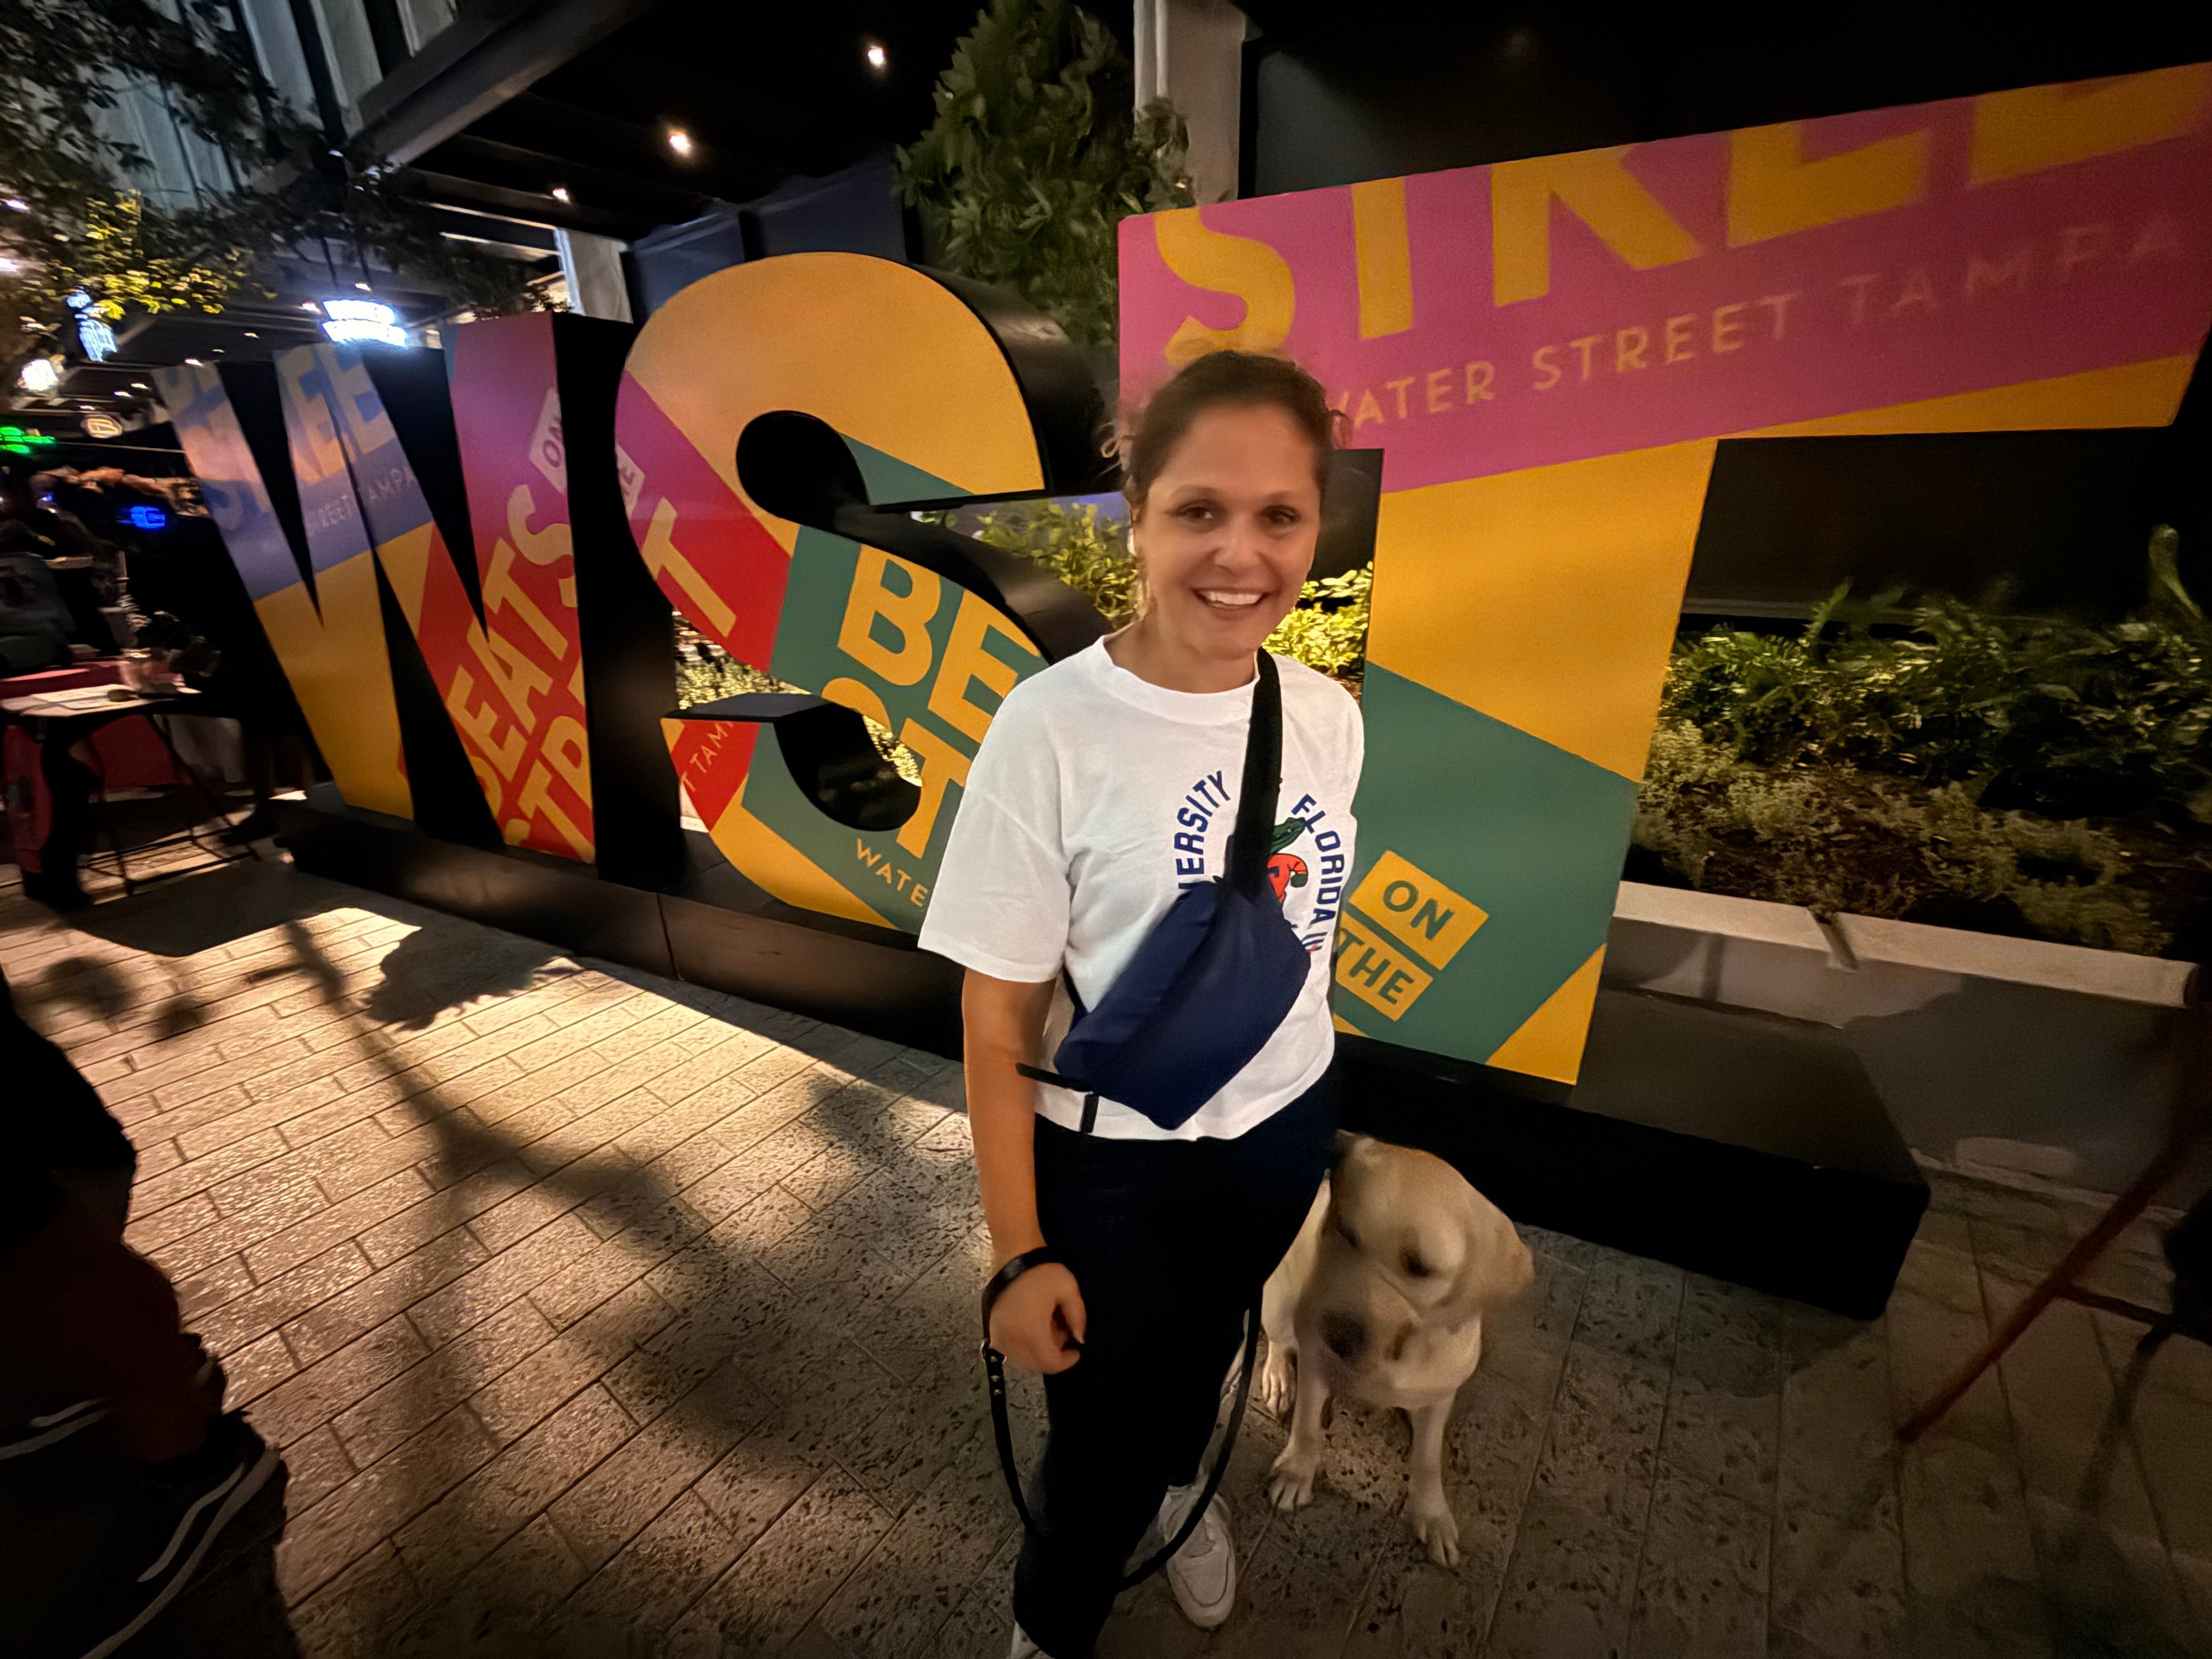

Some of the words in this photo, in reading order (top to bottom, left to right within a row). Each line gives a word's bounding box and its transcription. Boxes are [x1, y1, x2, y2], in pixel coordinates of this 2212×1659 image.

[1532, 290, 1803, 391] STREET
[1837, 213, 2186, 328] TAMPA
[837, 544, 1041, 744] BE
[689, 721, 734, 774] TAM
[1173, 770, 1231, 889] ERSITY
[1291, 793, 1345, 930] FLORIDA
[1338, 928, 1415, 1005] THE
[1383, 880, 1454, 940] ON
